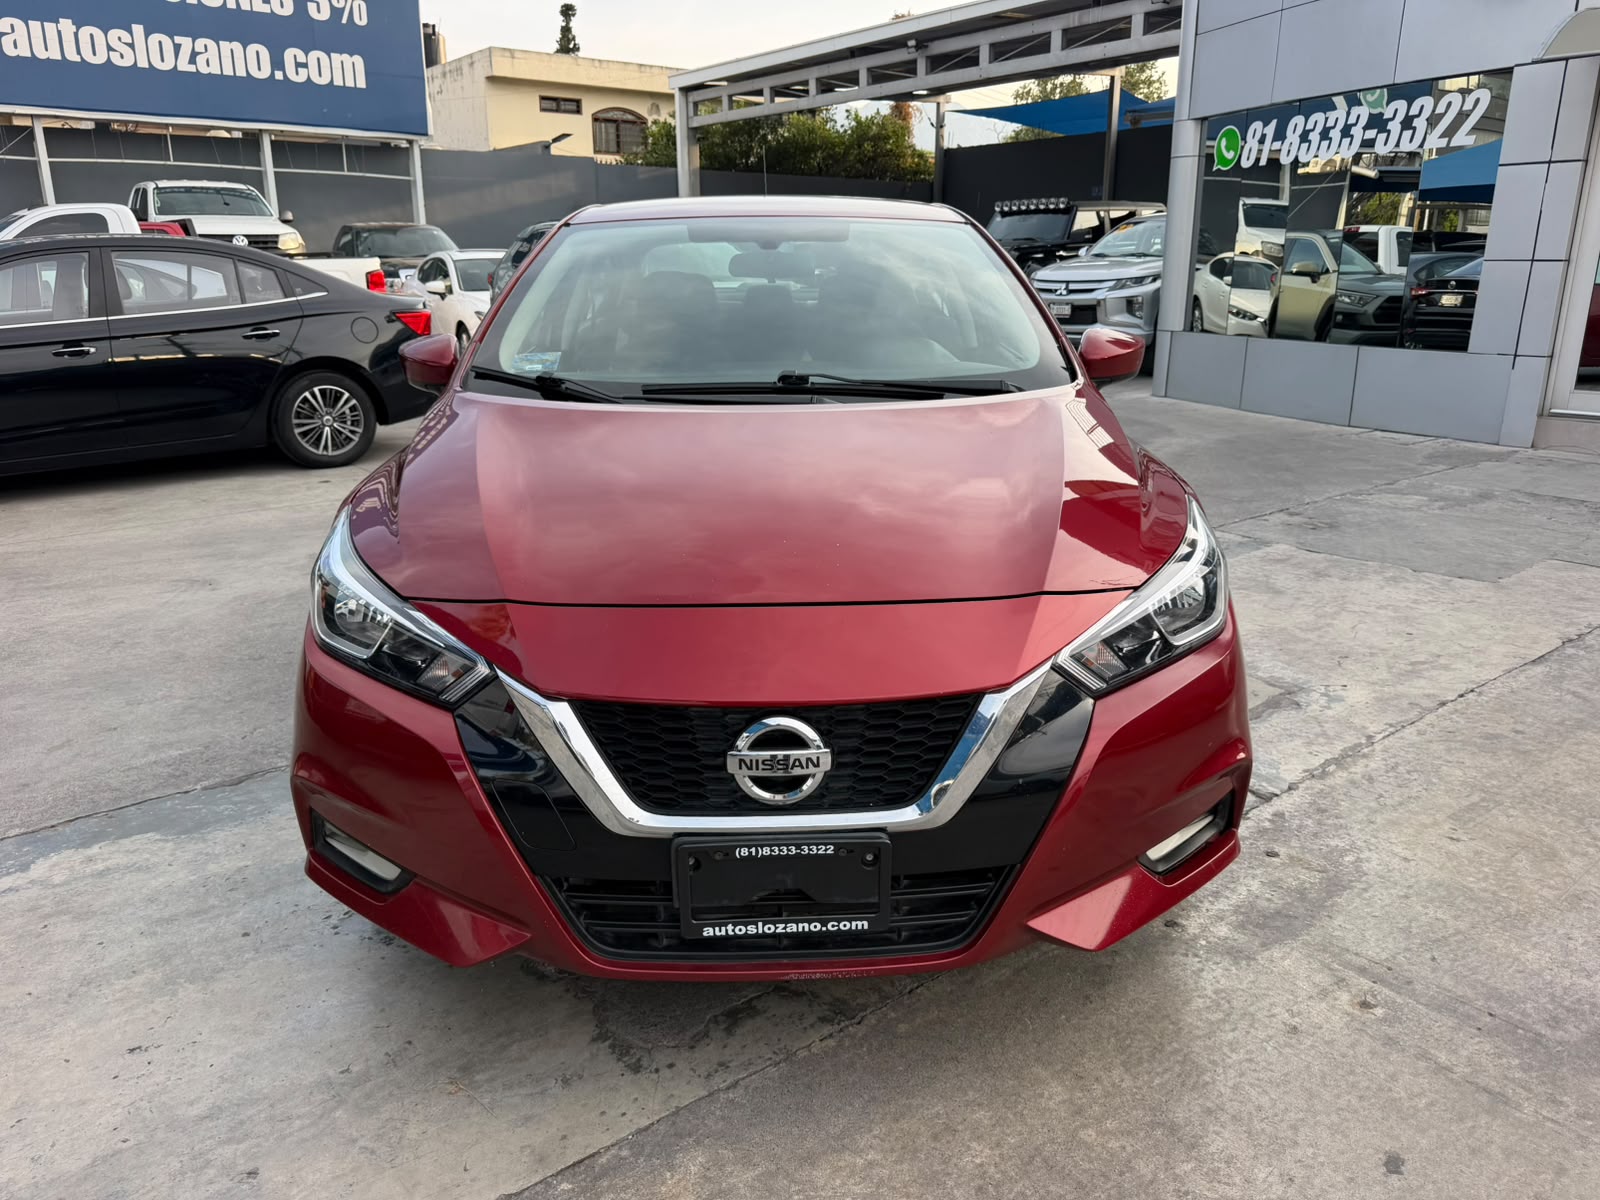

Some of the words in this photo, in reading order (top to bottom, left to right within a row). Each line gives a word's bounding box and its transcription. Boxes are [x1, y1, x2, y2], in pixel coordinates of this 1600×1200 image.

[1, 16, 367, 89] autoslozano.com
[1240, 88, 1492, 169] 81-8333-3322
[738, 755, 820, 771] NISSAN
[735, 845, 835, 858] (81)8333-3322
[702, 920, 869, 937] autoslozano.com
